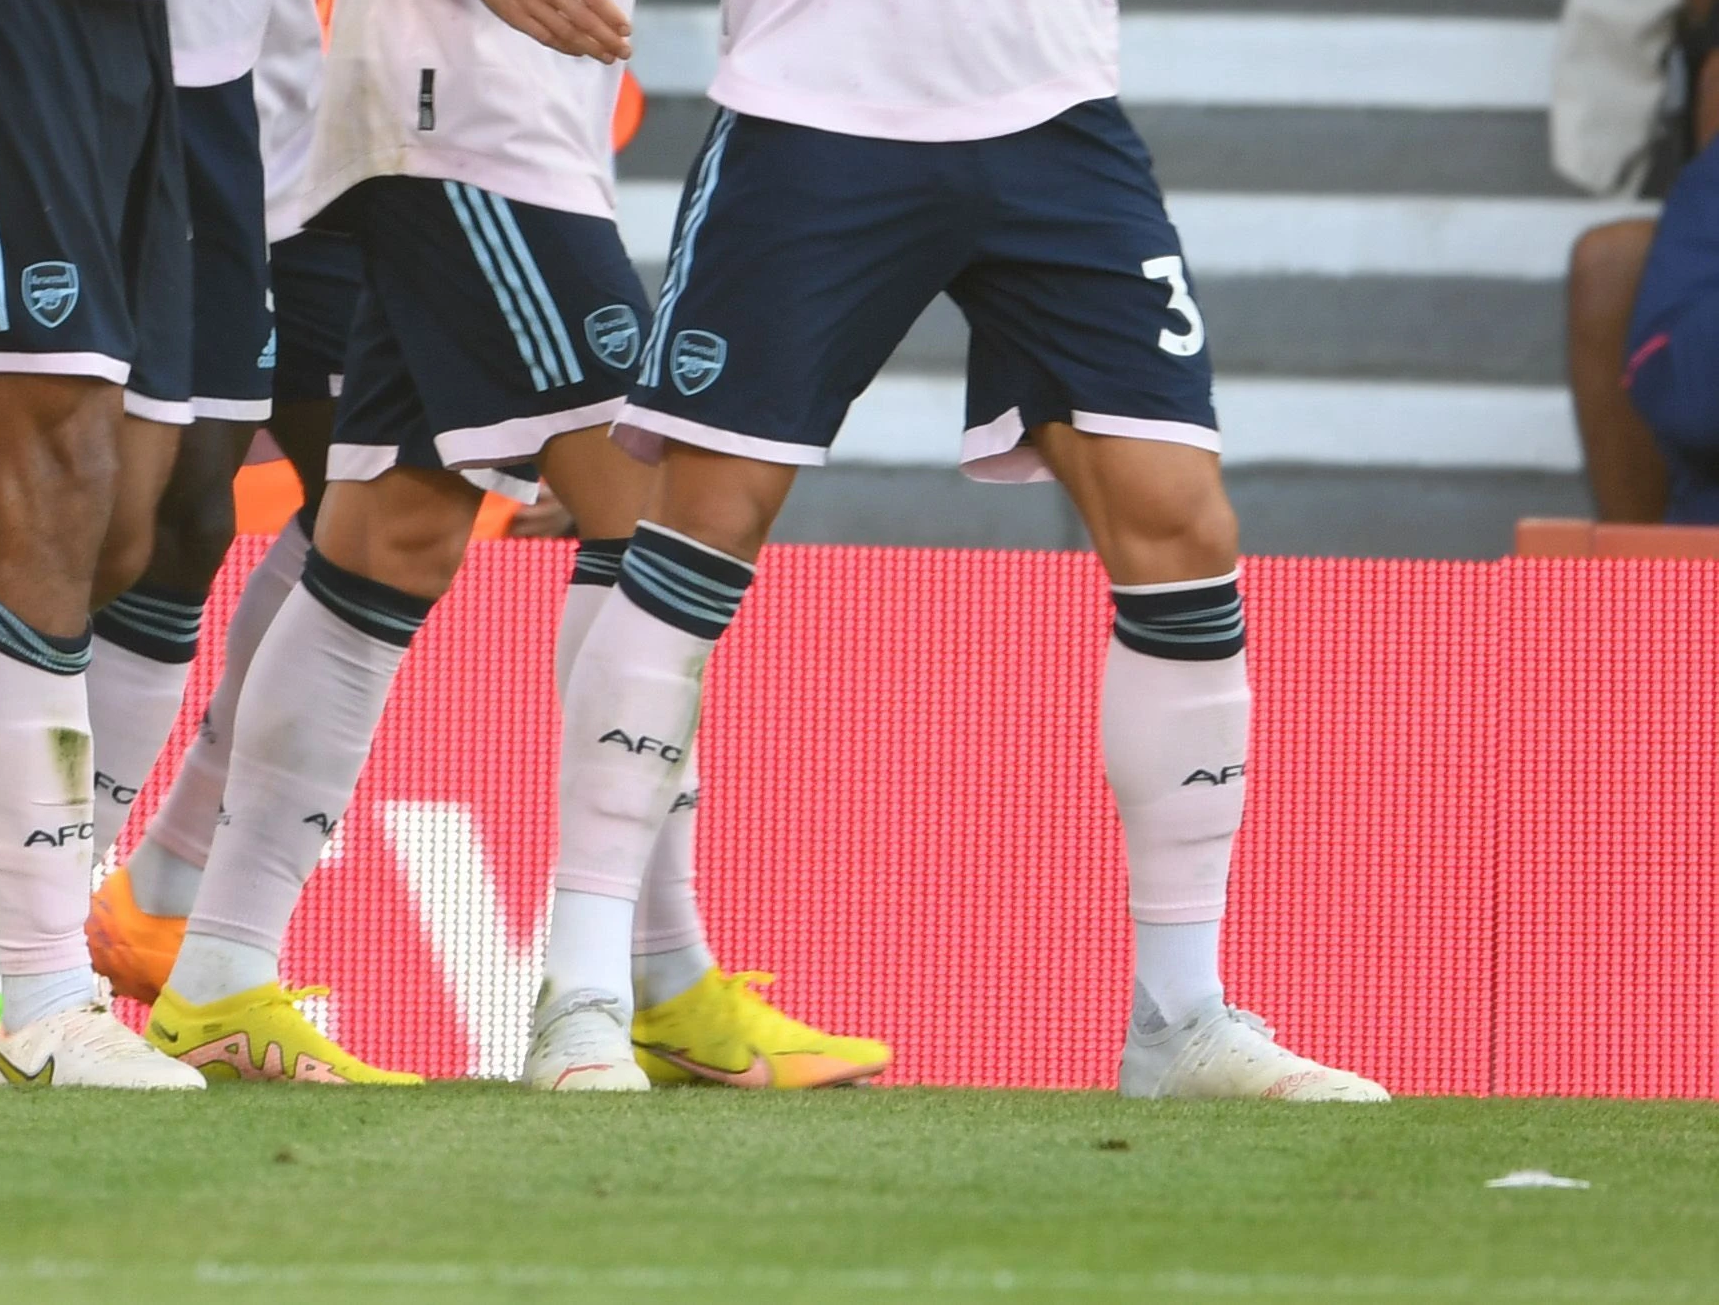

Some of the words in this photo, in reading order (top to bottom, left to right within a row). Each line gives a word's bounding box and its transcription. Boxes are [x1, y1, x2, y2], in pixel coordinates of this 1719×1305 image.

[1141, 255, 1205, 358] 3
[597, 728, 684, 764] AFC
[94, 770, 139, 805] FC
[1181, 764, 1247, 787] AF
[24, 822, 95, 848] AFC
